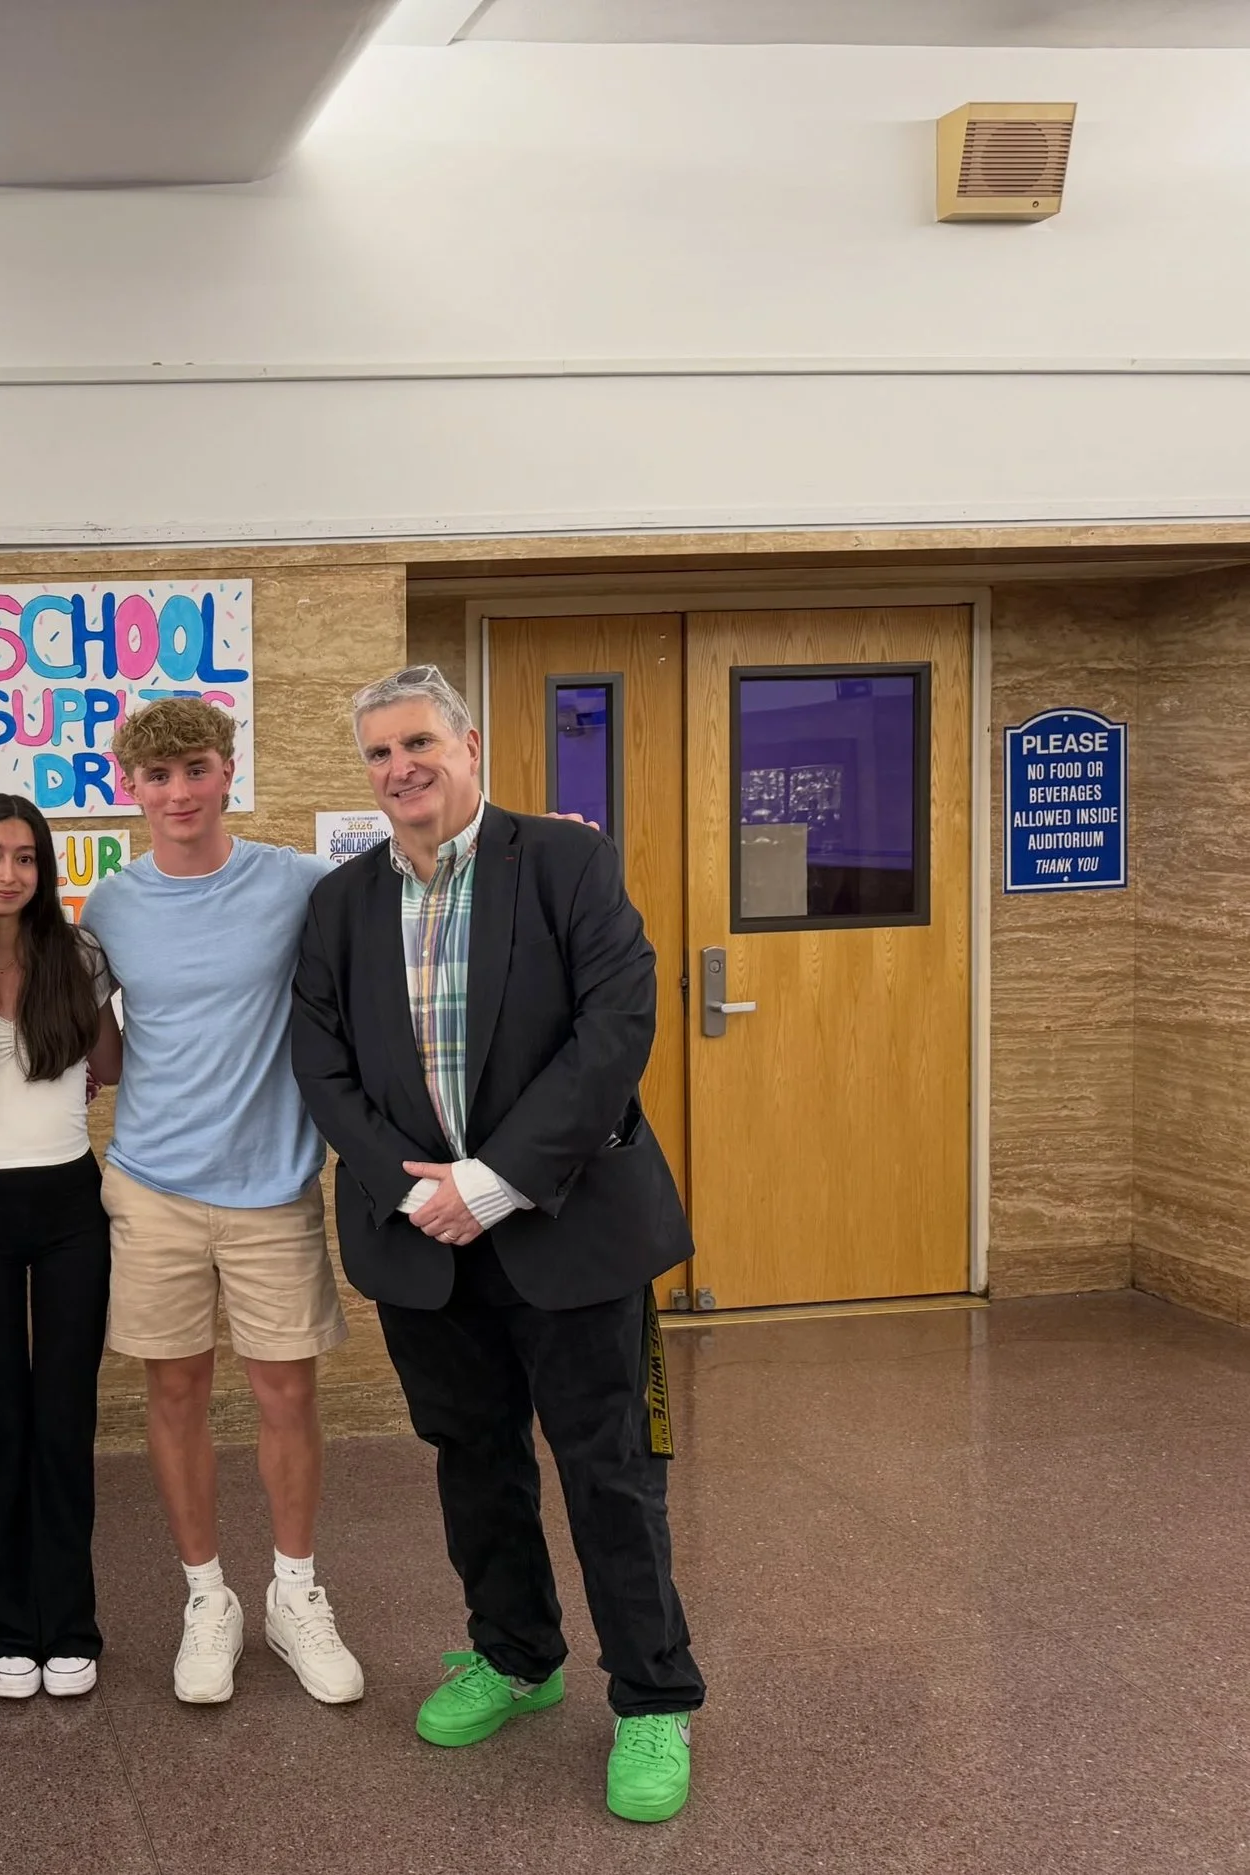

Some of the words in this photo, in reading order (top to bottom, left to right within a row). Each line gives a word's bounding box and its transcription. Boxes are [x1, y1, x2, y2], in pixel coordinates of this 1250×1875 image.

[1022, 732, 1109, 755] PLEASE
[1027, 764, 1044, 780] NO
[1050, 762, 1082, 779] FOOD
[1087, 761, 1103, 777] OR
[1029, 784, 1102, 803] BEVERAGES
[348, 821, 373, 831] 2026
[1014, 809, 1071, 828] ALLOWED
[1076, 807, 1118, 825] INSIDE
[332, 829, 388, 839] Community
[1028, 831, 1104, 850] AUDITORIUM
[1036, 857, 1073, 874] THANK
[1077, 857, 1099, 872] YOU
